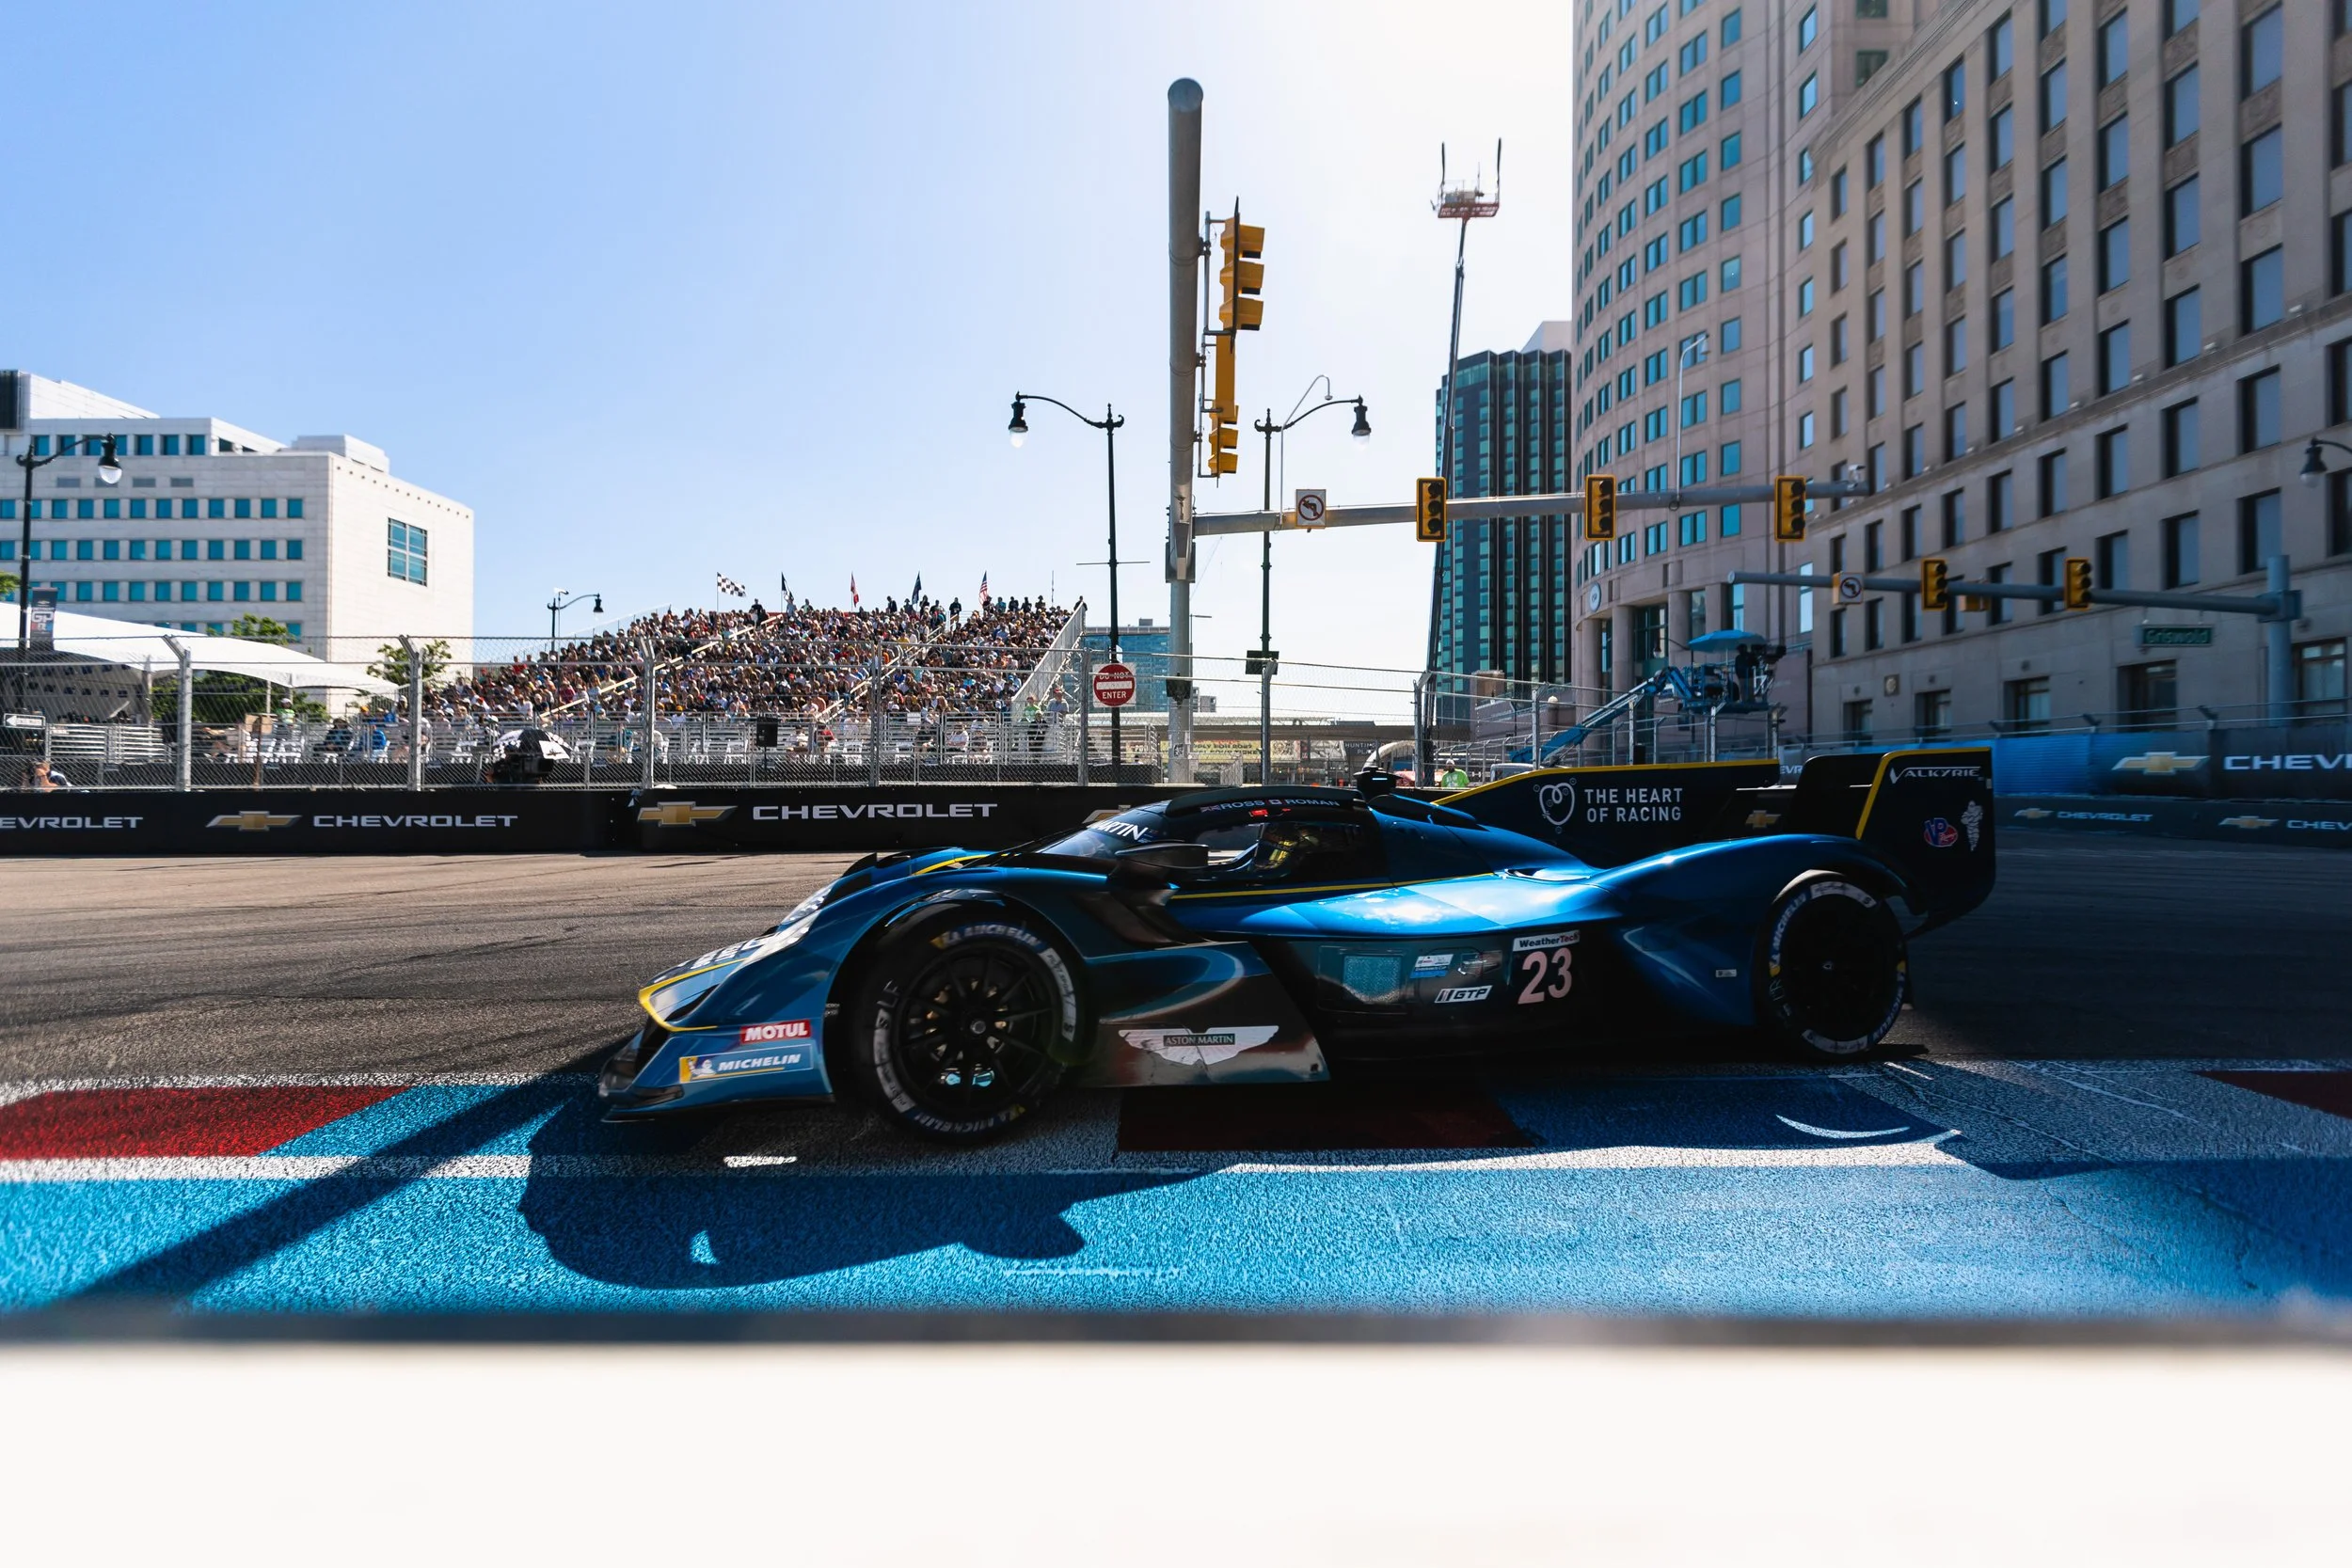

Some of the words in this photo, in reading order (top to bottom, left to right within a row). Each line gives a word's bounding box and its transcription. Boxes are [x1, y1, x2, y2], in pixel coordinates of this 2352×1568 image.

[31, 610, 55, 623] GP
[1102, 690, 1127, 700] ENTER
[2223, 753, 2352, 769] CHEV
[1889, 766, 1982, 784] VALKYRIE
[1584, 788, 1618, 804] THE
[1626, 787, 1683, 803] HEART
[753, 802, 998, 820] CHEVROLET
[1220, 800, 1264, 810] ROSS
[1285, 799, 1341, 807] ROMAN
[313, 815, 518, 828] CHEVROLET
[1586, 807, 1610, 823] OF
[1615, 806, 1682, 822] RACING
[2057, 811, 2153, 823] CHEVROLET
[1924, 816, 1949, 847] VP
[963, 924, 1044, 948] MICHELIN
[1519, 934, 1579, 948] WeatherTech
[1518, 947, 1573, 1005] 23
[1453, 988, 1487, 1000] GTP
[744, 1022, 808, 1042] MOTUL
[1165, 1036, 1197, 1046] ASTON
[1197, 1035, 1233, 1045] MARTIN
[718, 1053, 802, 1071] MICHELIN
